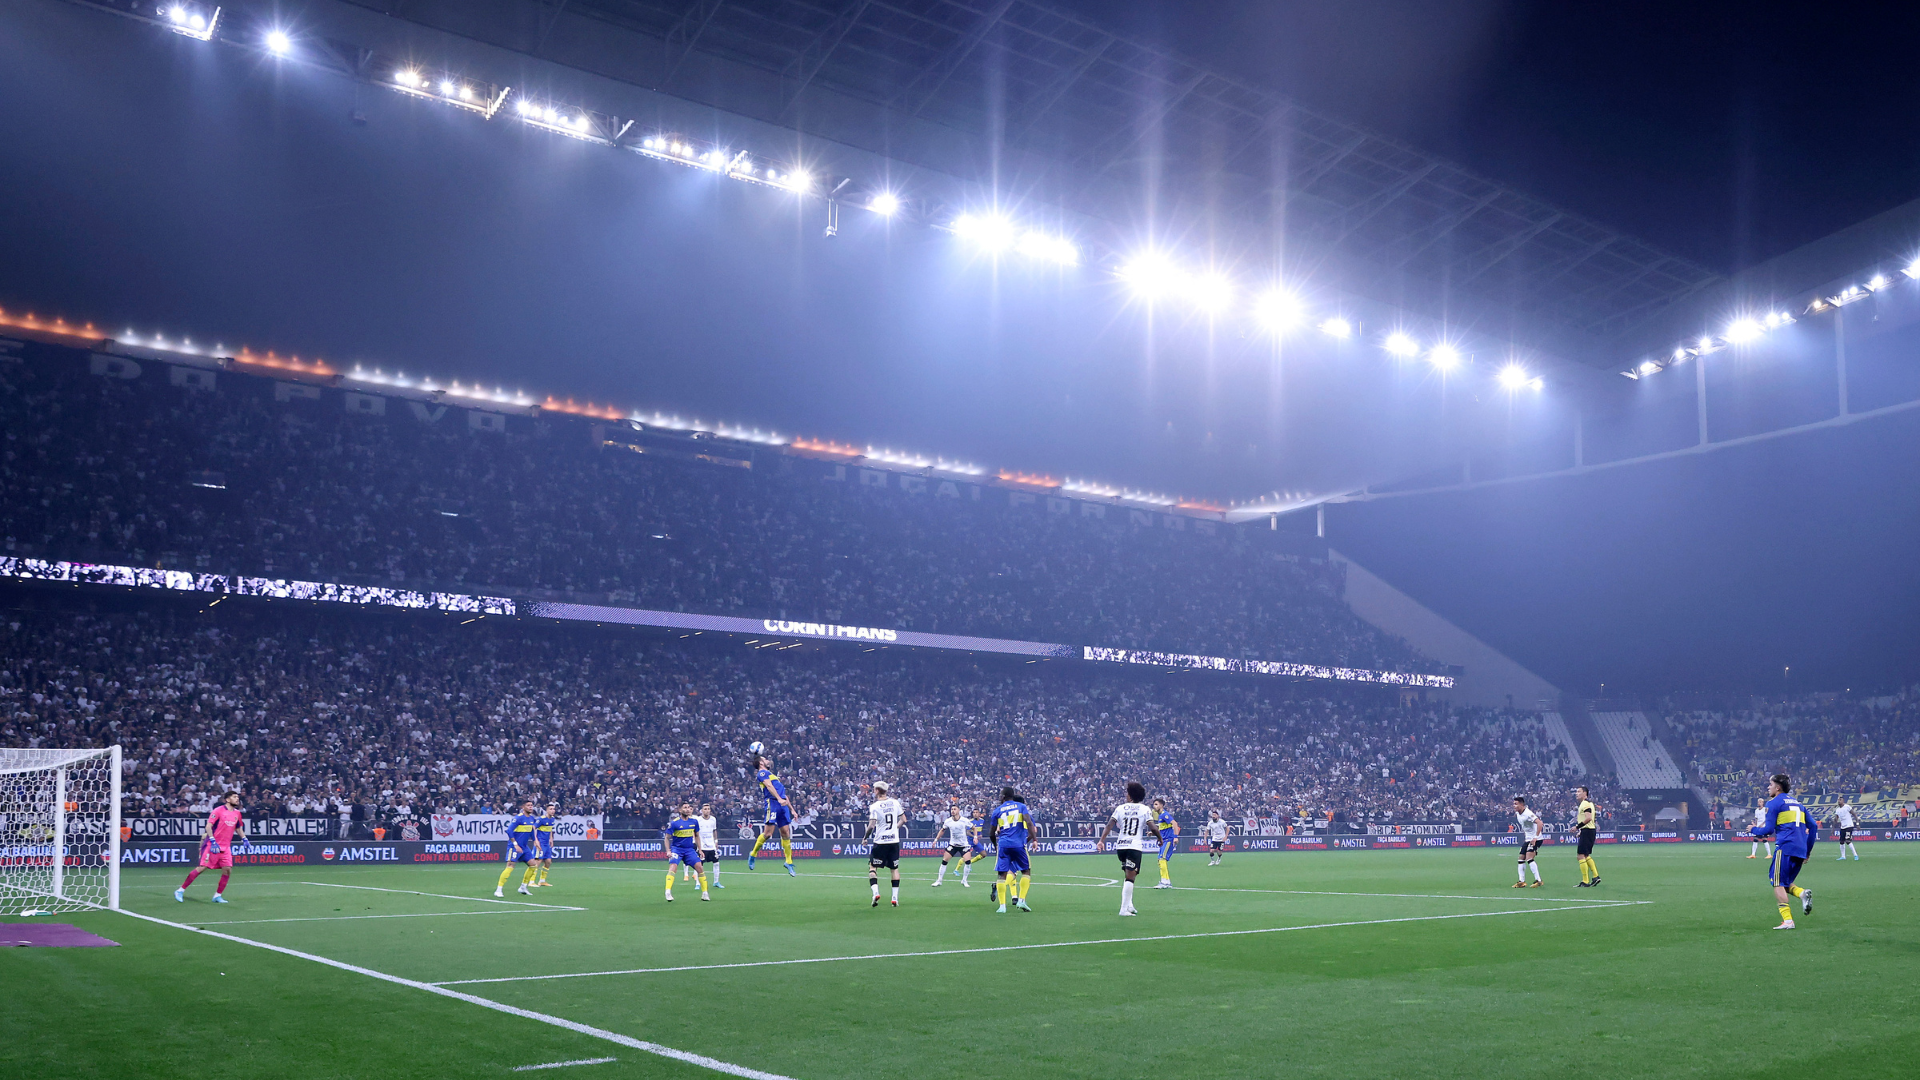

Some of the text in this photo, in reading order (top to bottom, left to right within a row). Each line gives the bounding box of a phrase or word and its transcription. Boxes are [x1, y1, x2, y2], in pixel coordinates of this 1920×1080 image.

[763, 619, 897, 641] CORINTHIANS
[1000, 809, 1019, 829] 17
[1788, 805, 1801, 827] 7
[885, 813, 893, 831] 9
[1123, 817, 1140, 836] 10
[1497, 836, 1519, 845] AMSTEL
[1625, 834, 1645, 842] AMSTEL
[1697, 833, 1725, 841] AMSTEL
[1893, 831, 1920, 840] AMSTE
[762, 842, 781, 852] FAÇA
[902, 841, 919, 850] FAÇA
[1067, 843, 1093, 851] RACISMO
[1250, 839, 1279, 850] AMSTEL
[1341, 838, 1367, 848] AMSTEL
[1422, 837, 1447, 847] AMSTEL
[425, 843, 491, 854] FAÇA BARULHO
[551, 846, 582, 859] STEL
[603, 843, 662, 853] FAÇA BARULHO
[717, 845, 743, 857] STEL
[844, 843, 874, 856] AMST
[120, 848, 191, 863] AMSTEL
[259, 854, 305, 863] RACISMO
[339, 847, 399, 861] AMSTEL
[414, 852, 500, 862] CONTRA O RACISMO
